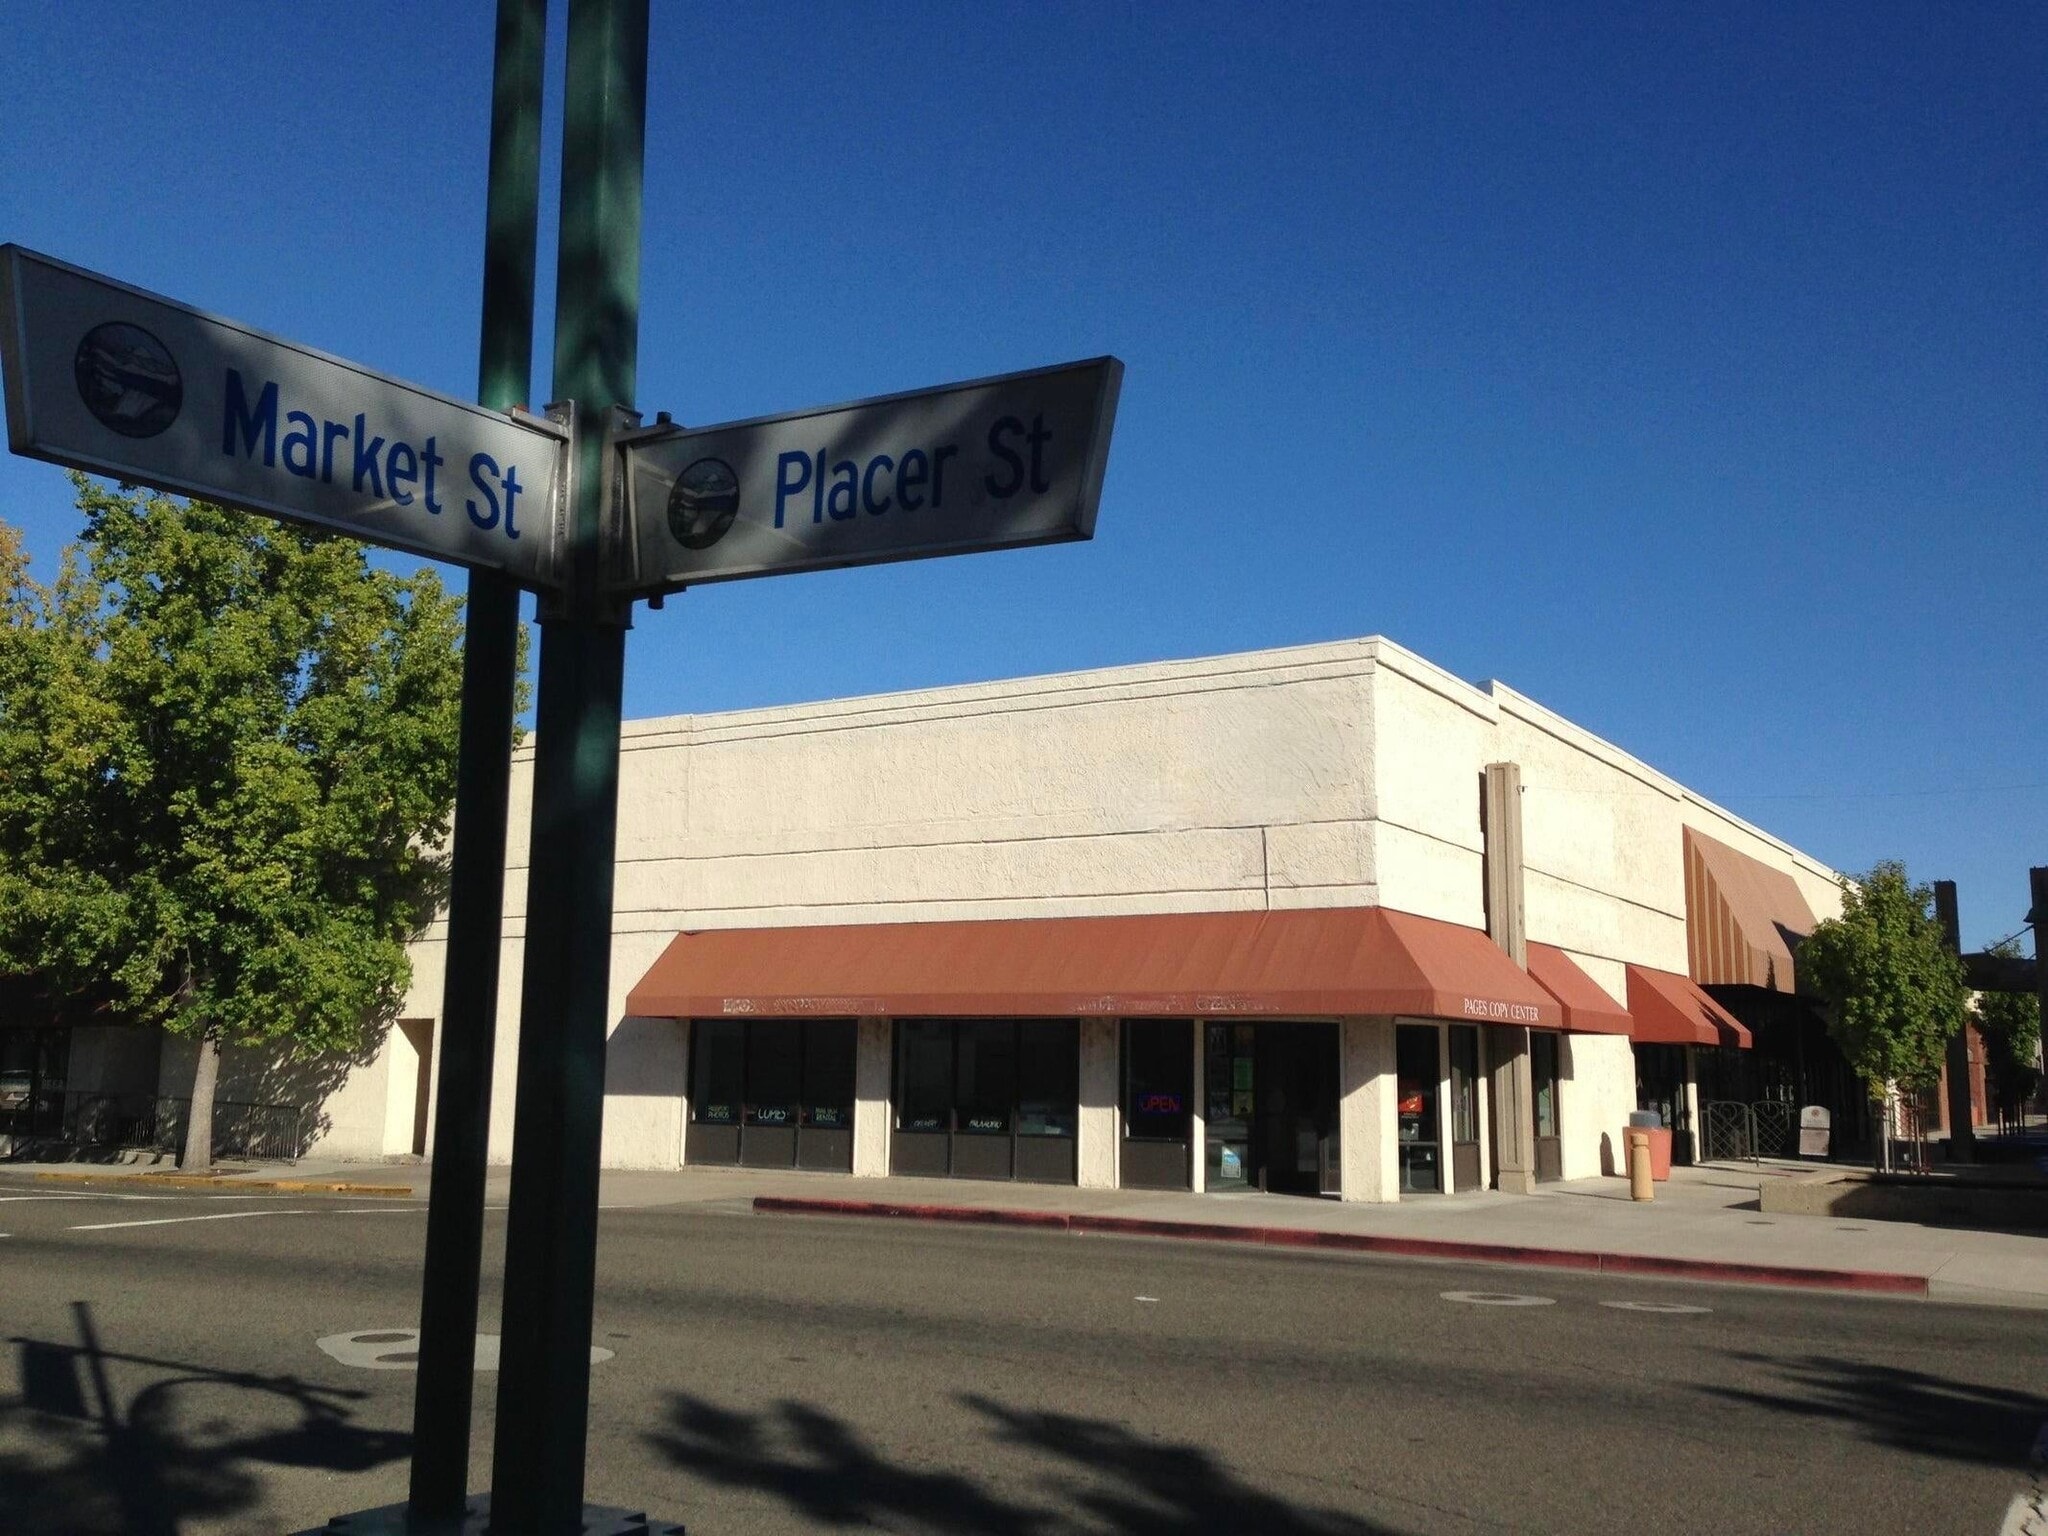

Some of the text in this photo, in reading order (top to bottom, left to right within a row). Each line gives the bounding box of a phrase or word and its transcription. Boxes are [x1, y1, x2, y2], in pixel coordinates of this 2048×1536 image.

[222, 367, 444, 515] Market
[466, 452, 523, 540] St
[774, 412, 1053, 529] Placer St
[1464, 998, 1540, 1021] PAGES COPY CENTER
[1139, 1094, 1178, 1112] OPEN
